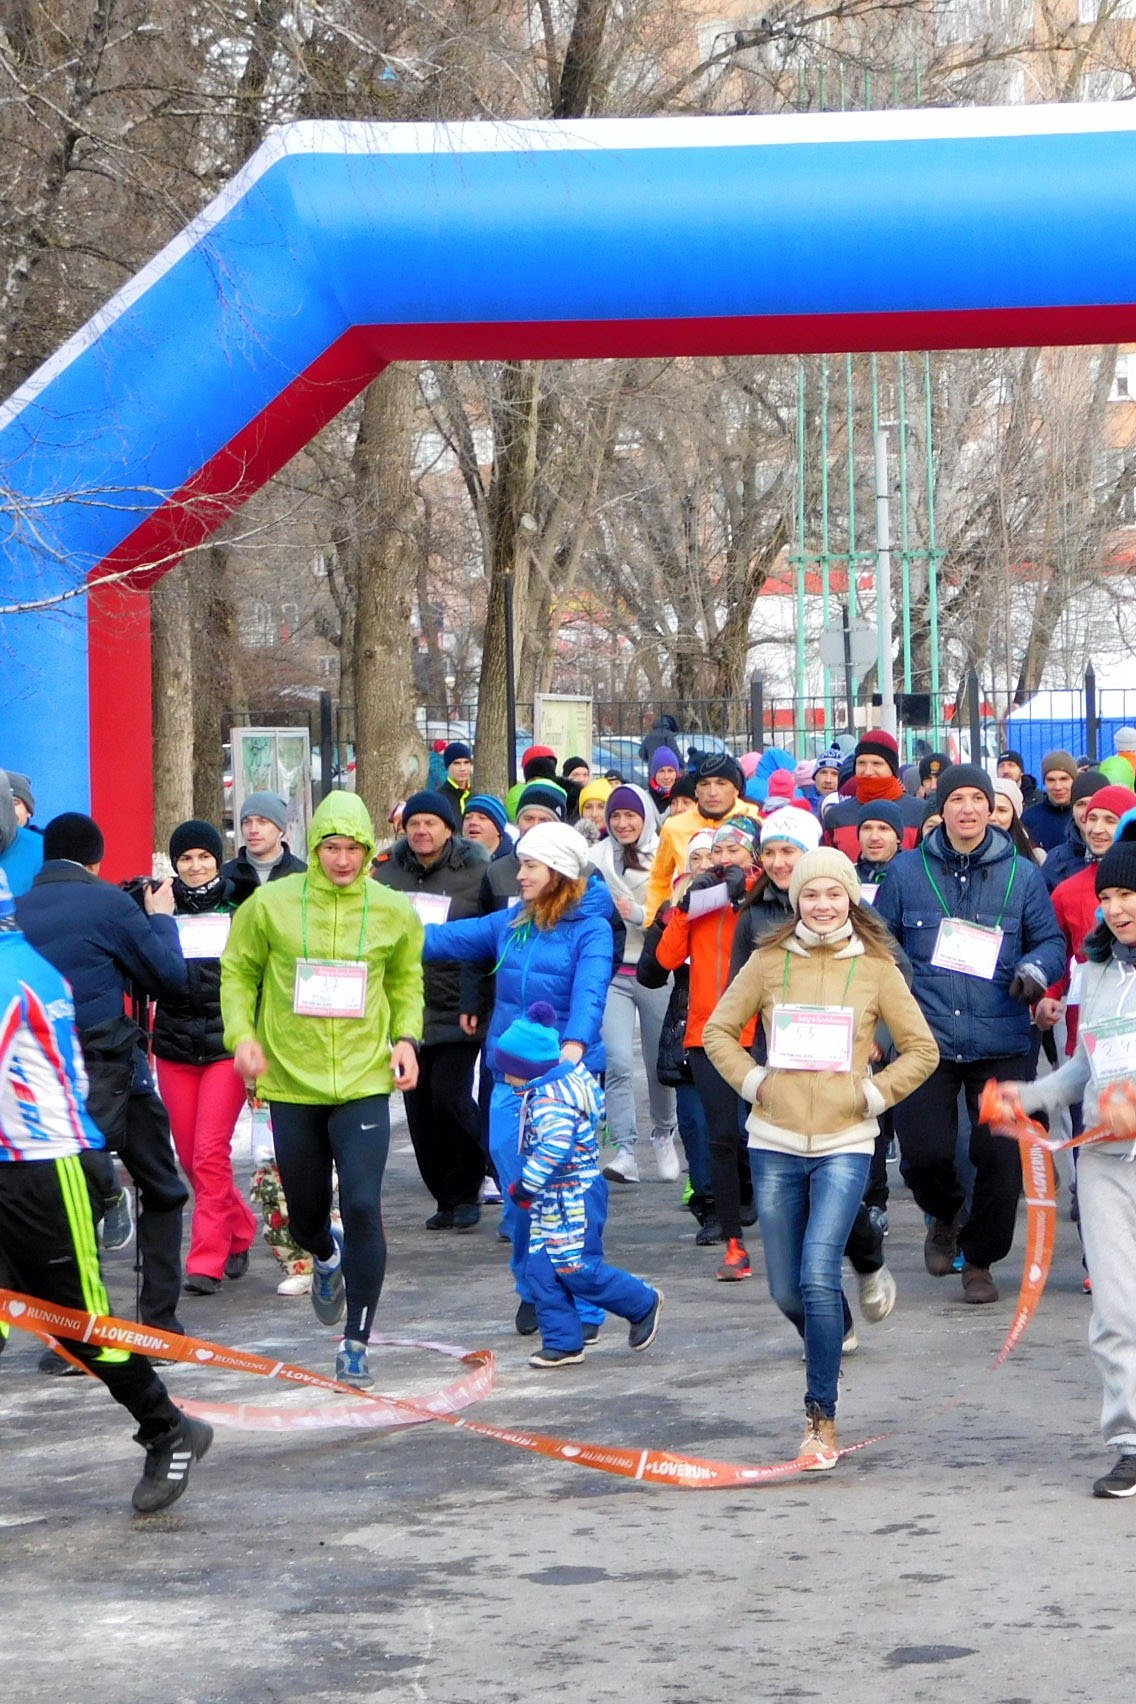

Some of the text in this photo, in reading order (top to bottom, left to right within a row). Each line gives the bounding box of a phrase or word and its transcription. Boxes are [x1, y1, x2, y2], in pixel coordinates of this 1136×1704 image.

[2, 1300, 81, 1331] I RUNNING
[101, 1326, 163, 1350] LOVERUN
[213, 1354, 268, 1371] RUNNING
[652, 1460, 711, 1480] LOVERUN
